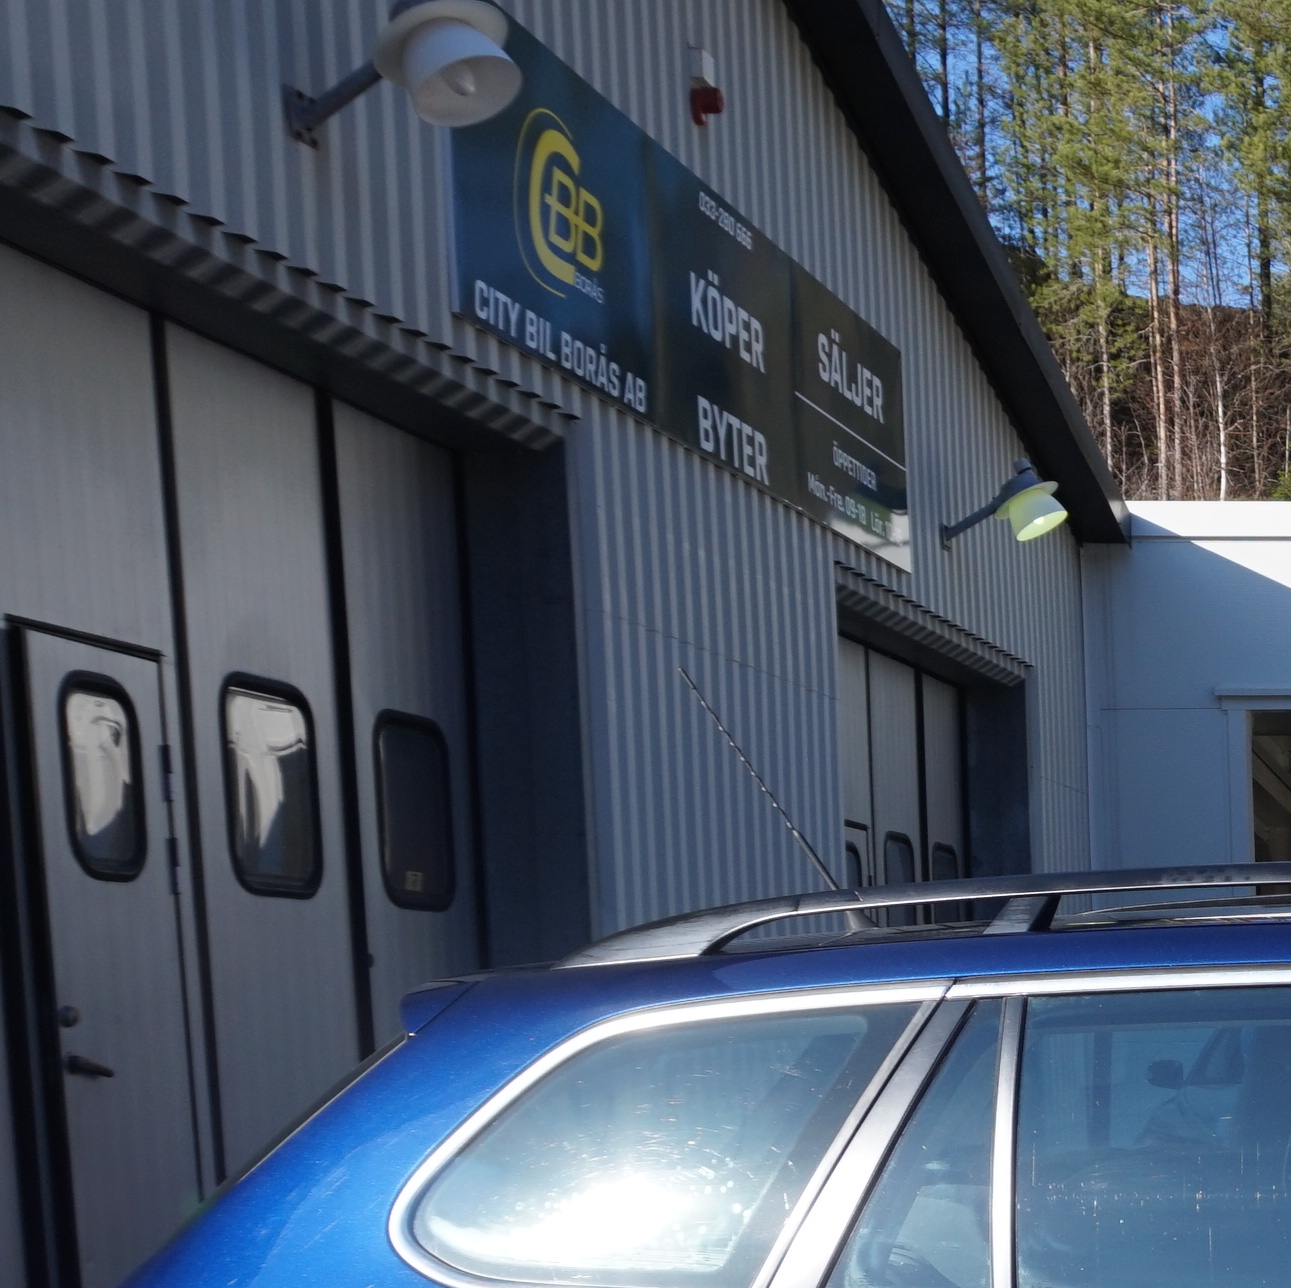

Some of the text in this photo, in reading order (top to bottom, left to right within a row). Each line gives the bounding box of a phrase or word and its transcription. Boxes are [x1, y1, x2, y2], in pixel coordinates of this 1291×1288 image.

[474, 279, 649, 413] CITY BIL BORÅS AB
[690, 268, 766, 374] KÖPER
[817, 328, 885, 425] SÄLJER
[697, 394, 770, 486] BYTER
[832, 440, 878, 492] ÖPPETTIDER
